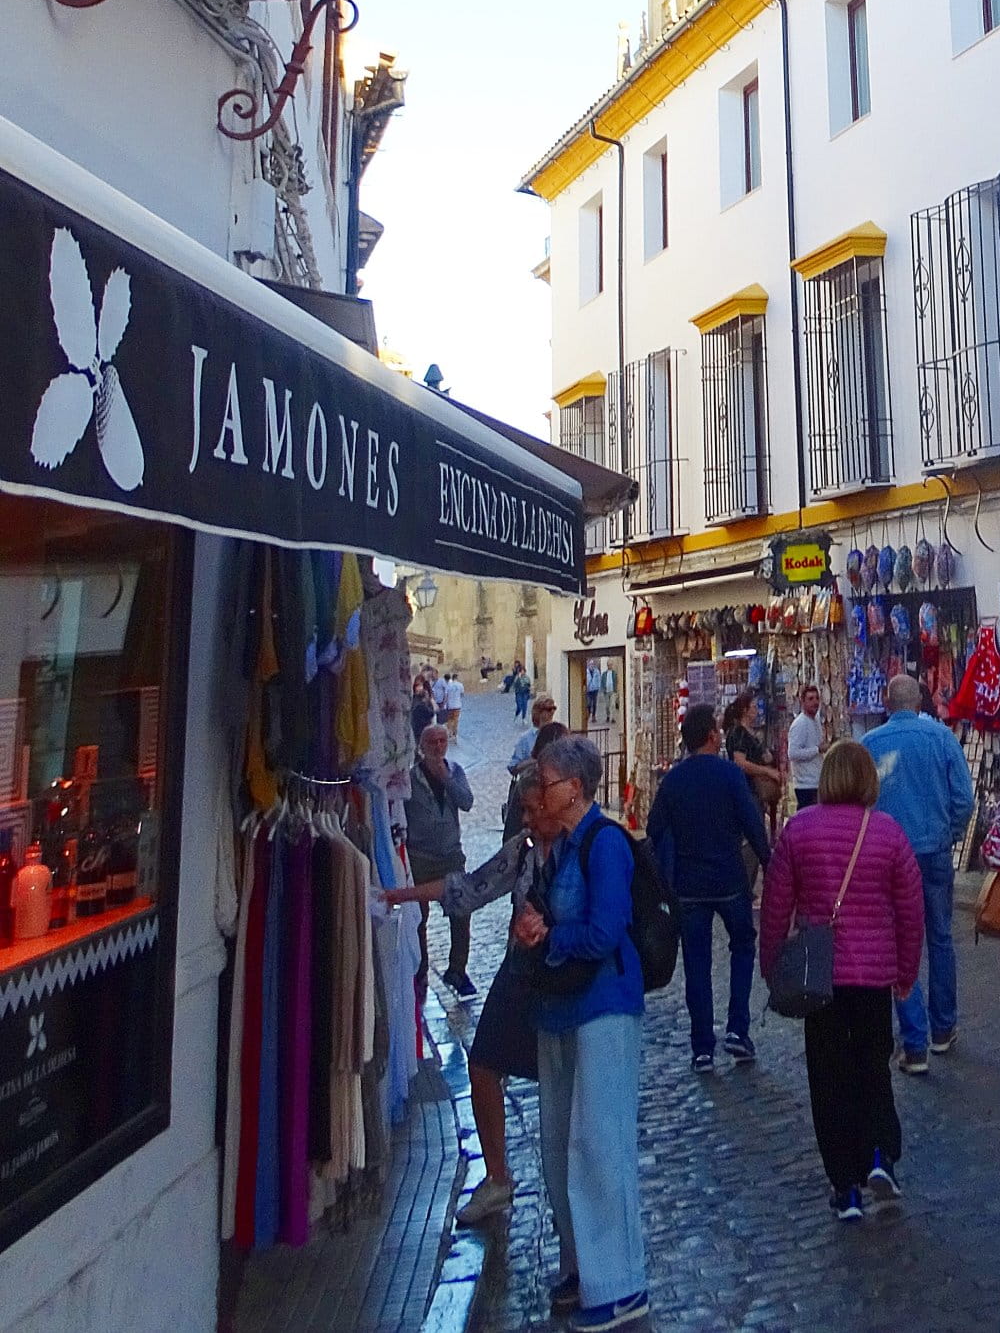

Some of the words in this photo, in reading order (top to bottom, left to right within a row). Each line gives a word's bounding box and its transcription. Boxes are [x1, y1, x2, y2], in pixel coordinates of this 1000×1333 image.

[189, 344, 399, 516] JAMONES
[439, 462, 498, 540] ENCINA
[500, 491, 518, 547] DE
[520, 500, 536, 552] LA
[784, 555, 823, 570] Kodak
